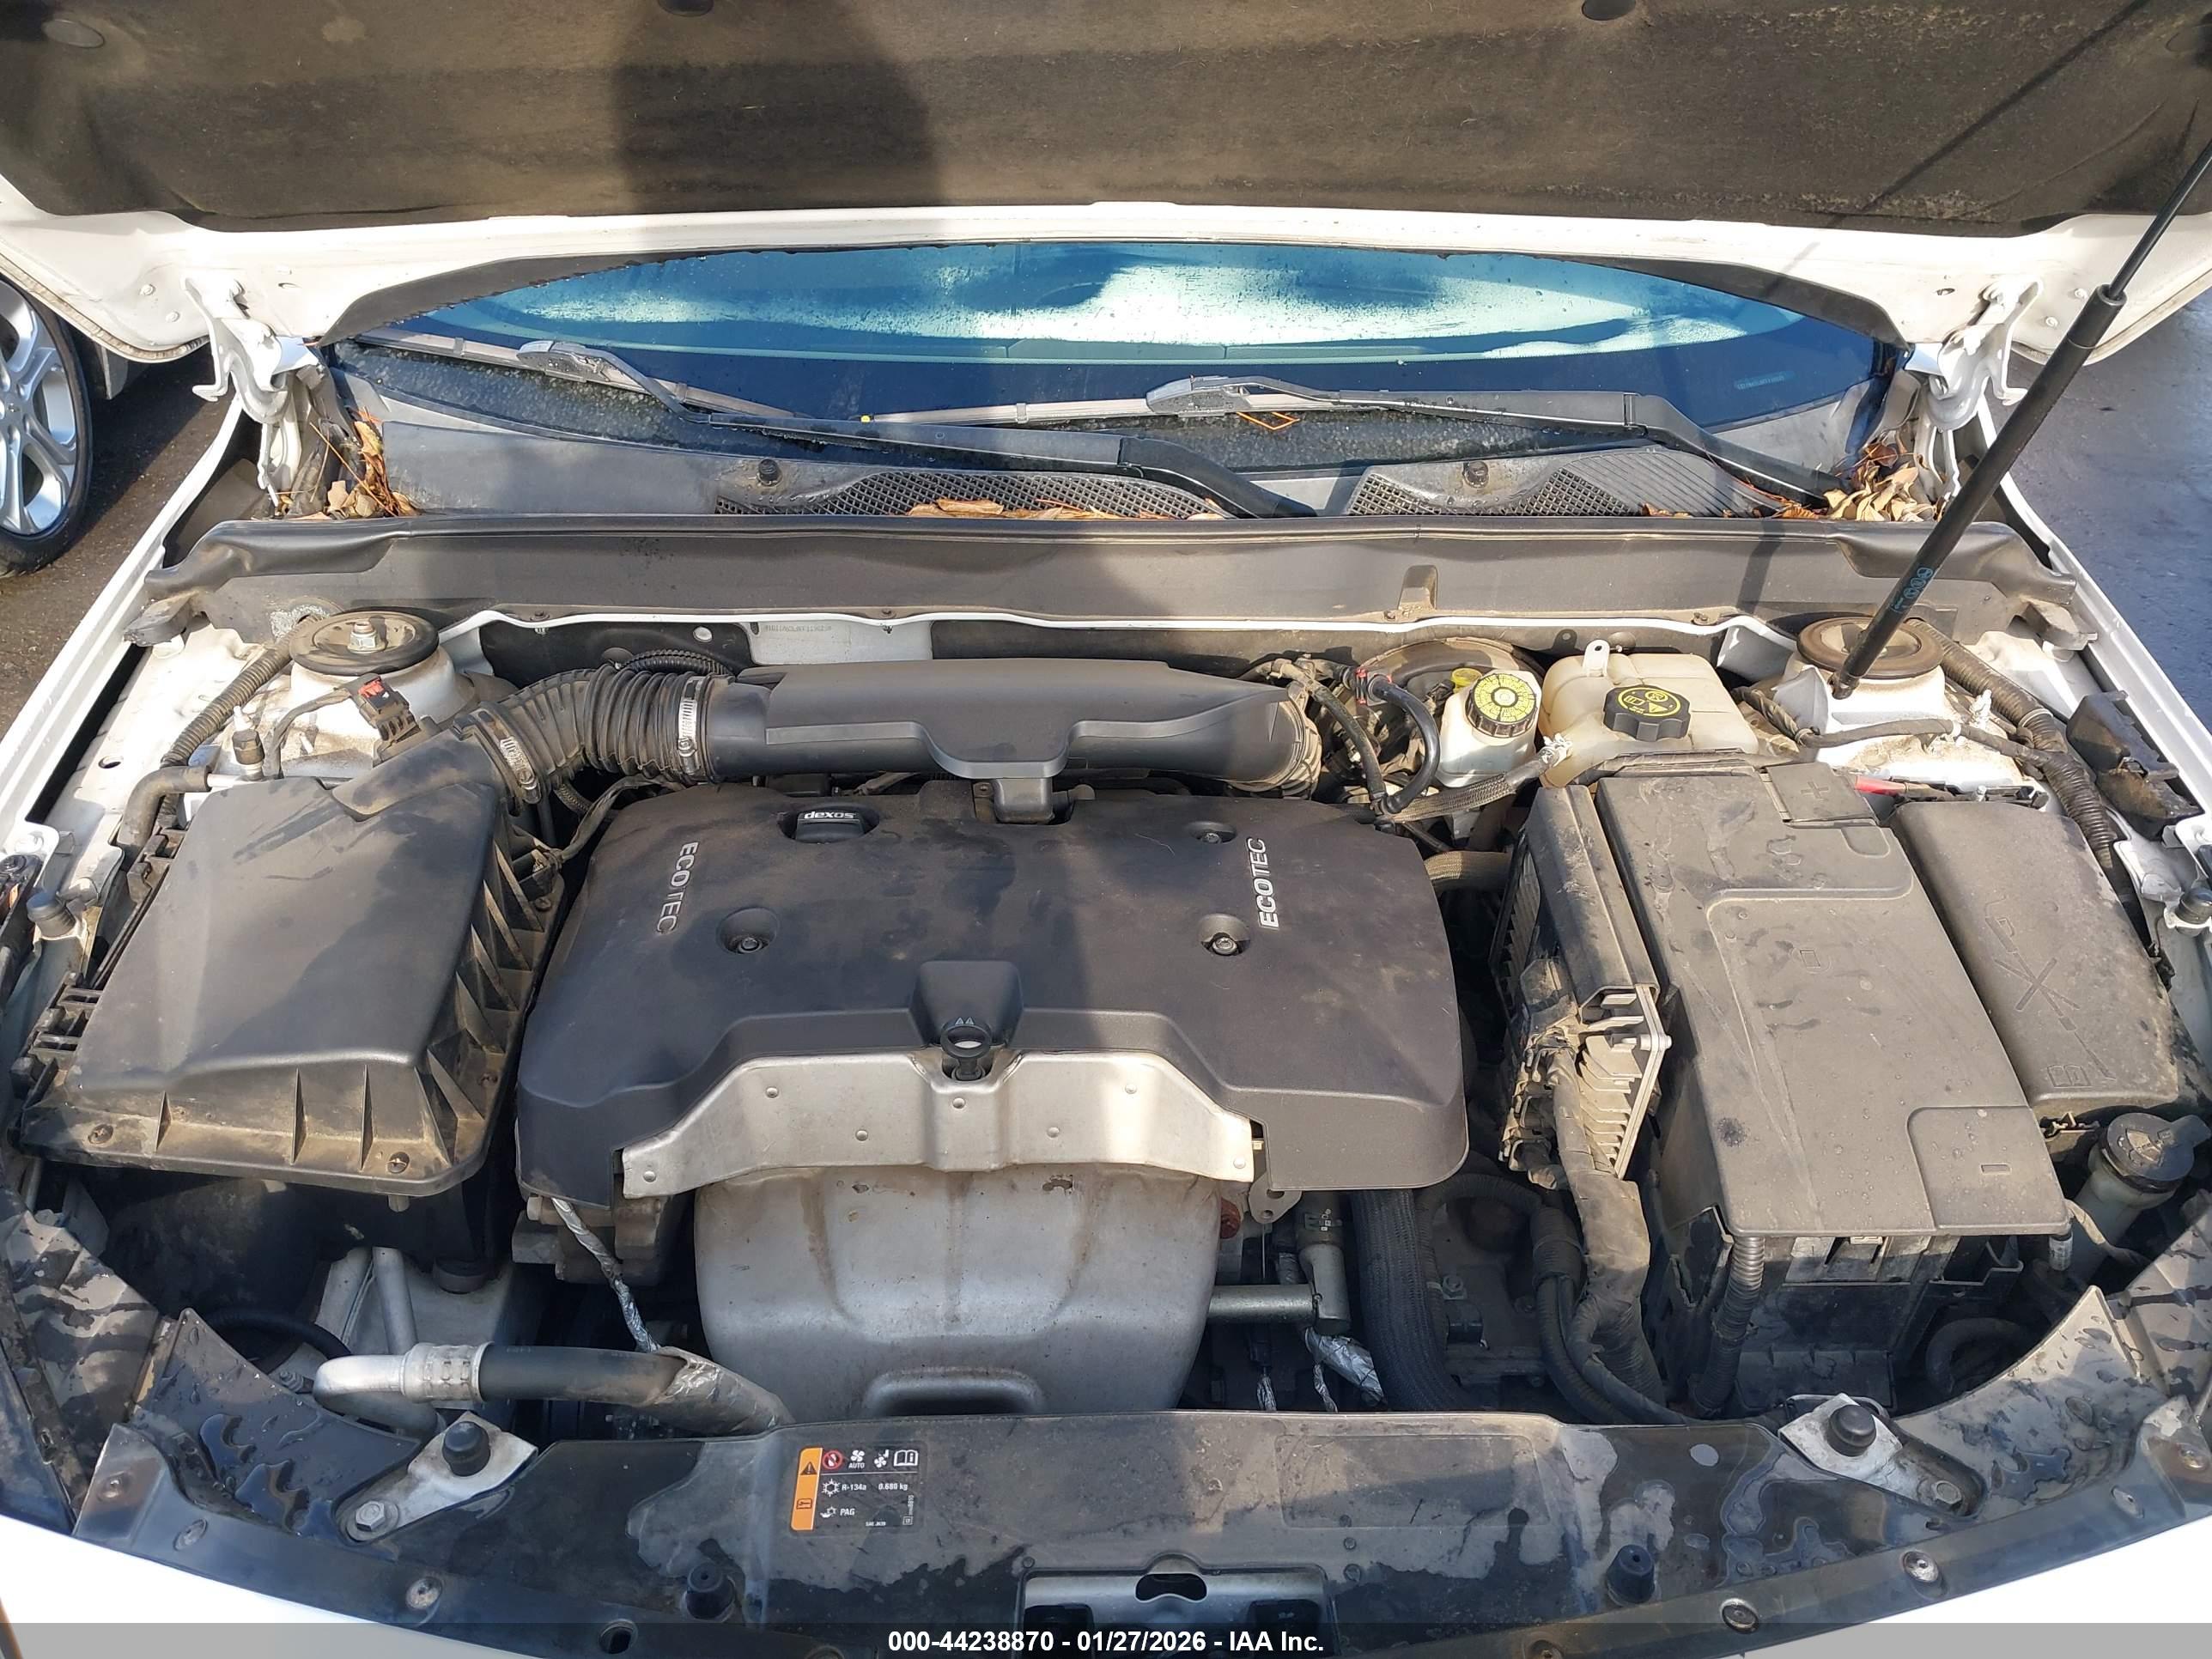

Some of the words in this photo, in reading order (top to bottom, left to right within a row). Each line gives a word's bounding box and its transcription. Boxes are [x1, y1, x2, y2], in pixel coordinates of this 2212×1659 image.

[803, 809, 855, 820] dexos
[655, 841, 700, 934] ECOTEC
[1246, 836, 1279, 929] ECOTEC
[899, 1483, 908, 1492] kg
[839, 1508, 855, 1516] PAG
